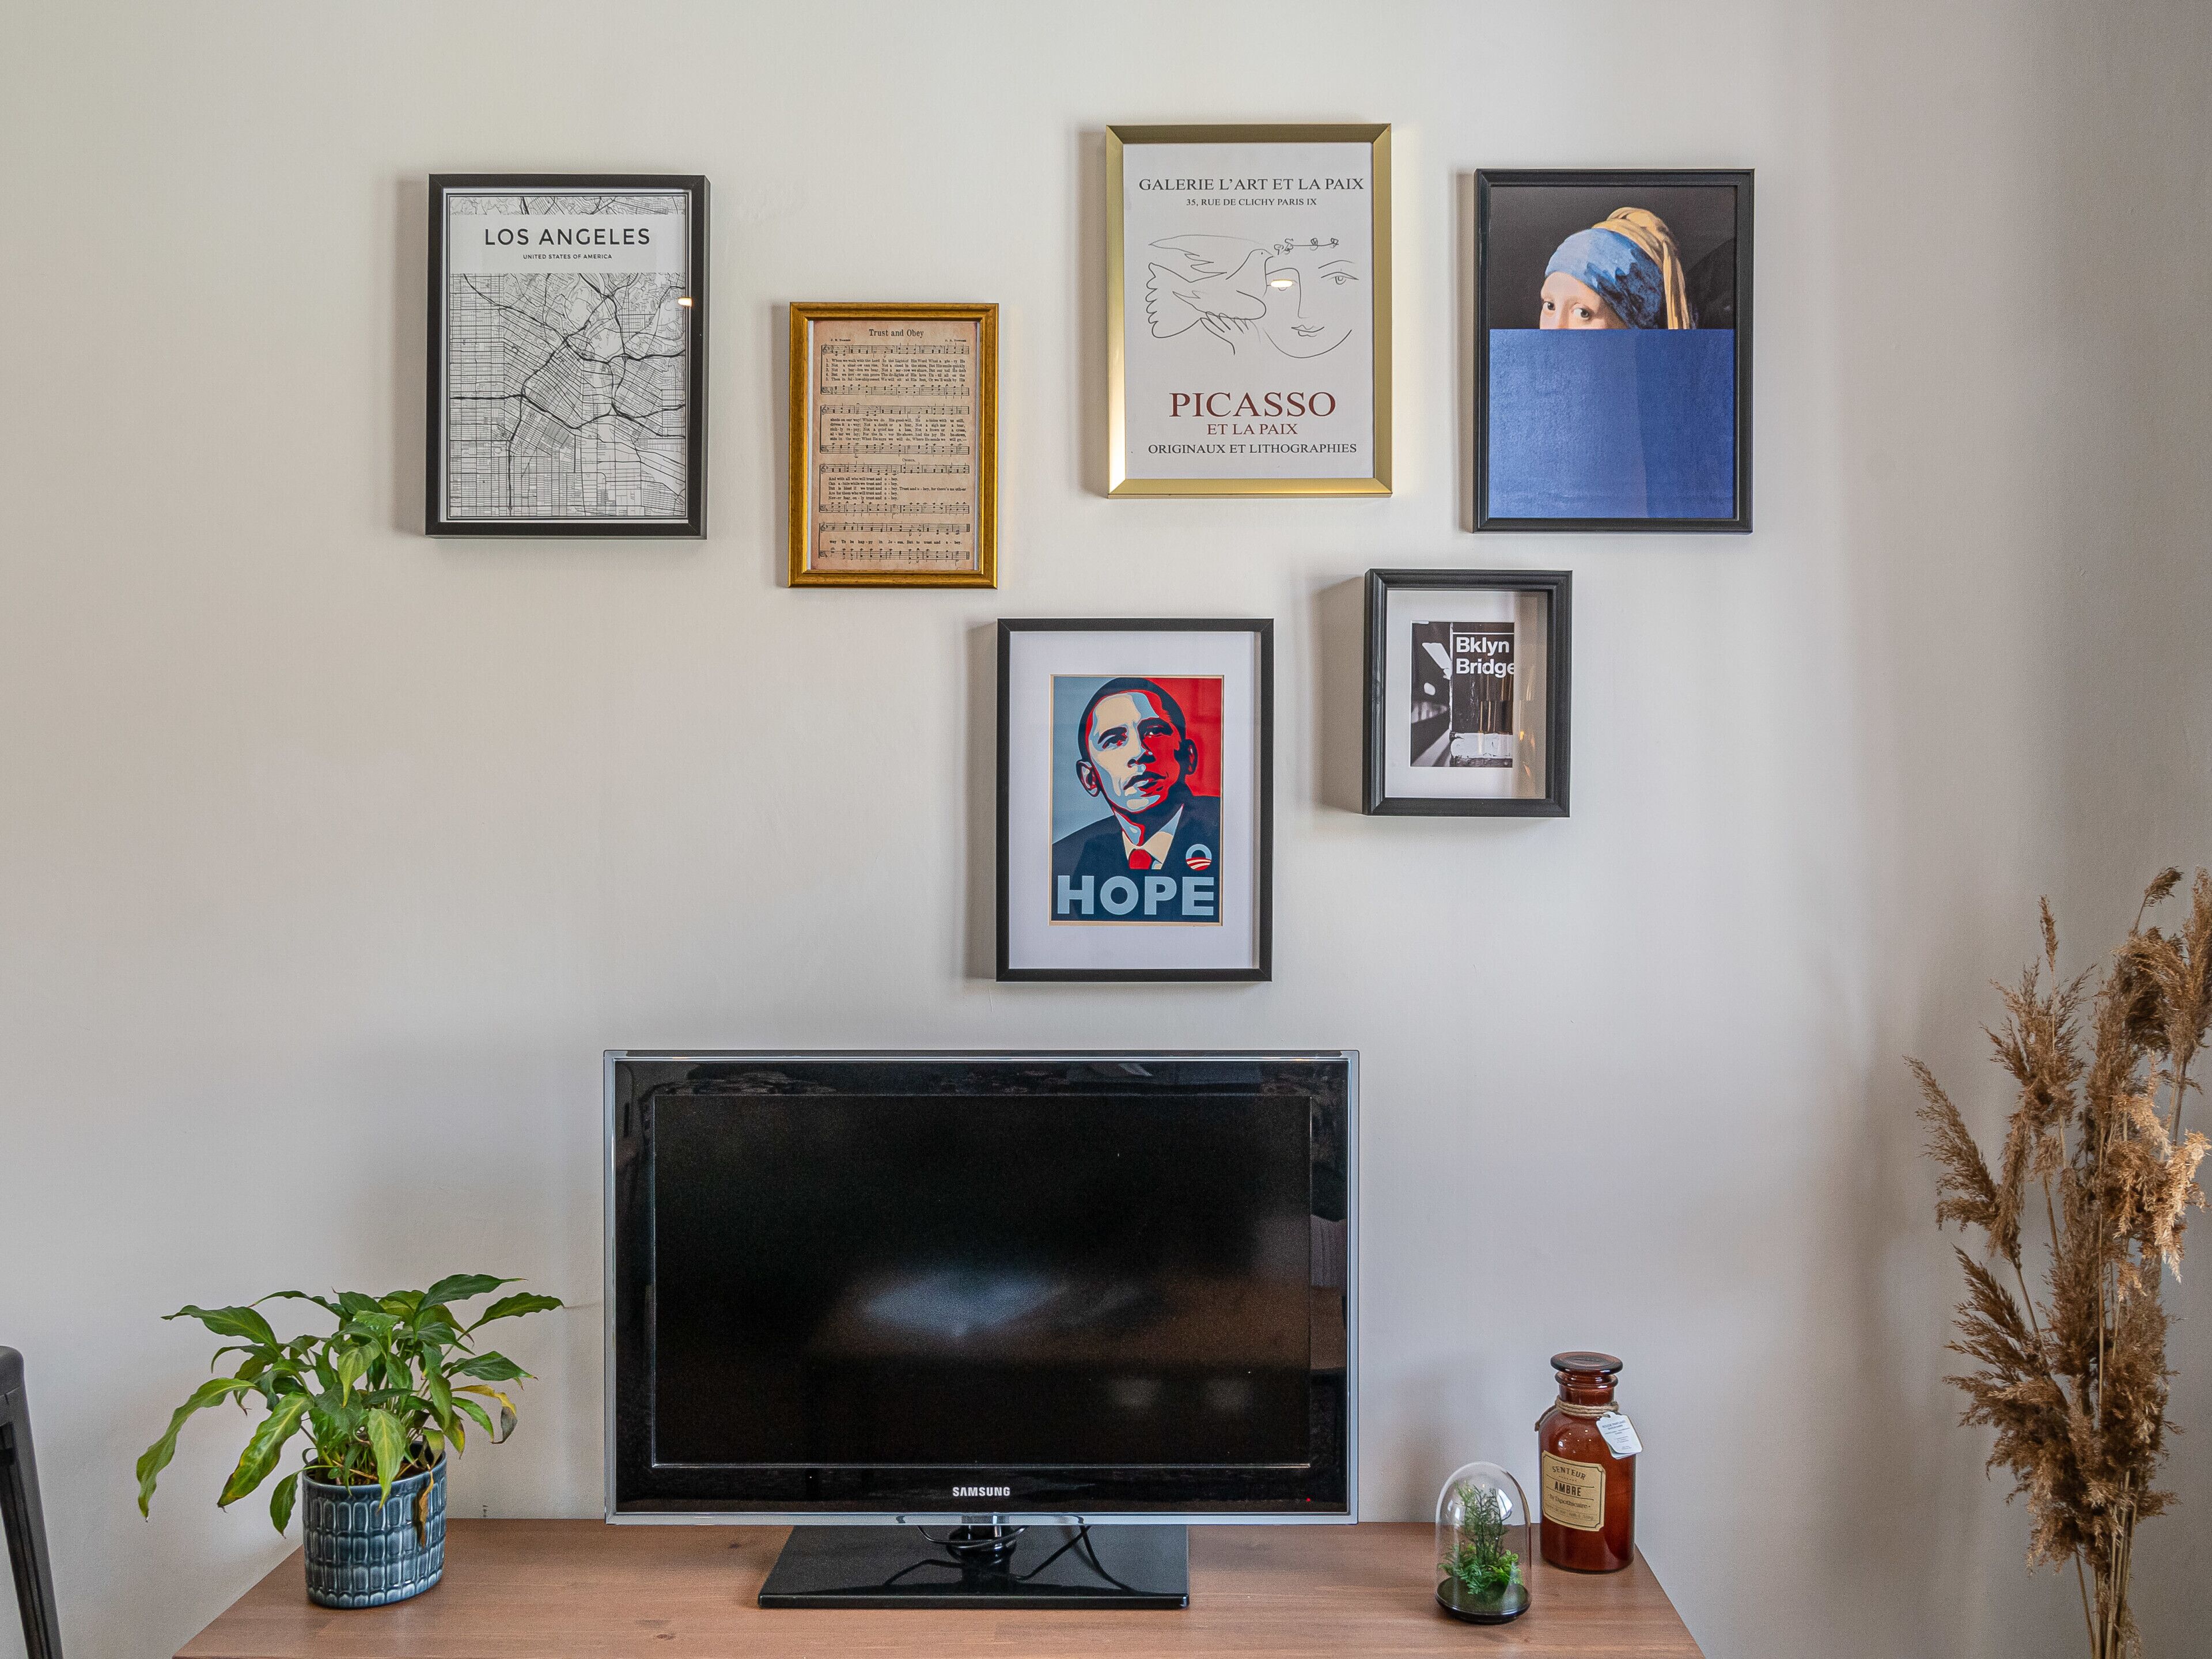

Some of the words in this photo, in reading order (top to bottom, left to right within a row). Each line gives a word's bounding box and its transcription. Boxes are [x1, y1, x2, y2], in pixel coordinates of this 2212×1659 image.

[1139, 179, 1214, 190] GALERIE
[1219, 179, 1267, 190] L'ART
[1272, 179, 1293, 190] ET
[1298, 179, 1320, 190] LA
[1325, 178, 1363, 190] PAIX
[485, 228, 529, 245] LOS
[539, 228, 650, 245] ANGELES
[907, 329, 924, 338] Obey
[1169, 392, 1336, 417] PICASSO
[1207, 424, 1228, 435] ET
[1233, 424, 1255, 435] LA
[1259, 423, 1297, 435] PAIX
[1148, 444, 1225, 454] ORIGINAUX
[1229, 444, 1246, 453] ET
[1249, 444, 1357, 453] LITHOGRAPHIES
[1456, 637, 1509, 656] Bklyn
[1456, 658, 1514, 678] Bridge
[1058, 875, 1214, 916] HOPE
[1552, 1465, 1586, 1480] SENTEUR
[953, 1487, 1010, 1497] SAMSUNG
[1554, 1481, 1581, 1497] AMBRE
